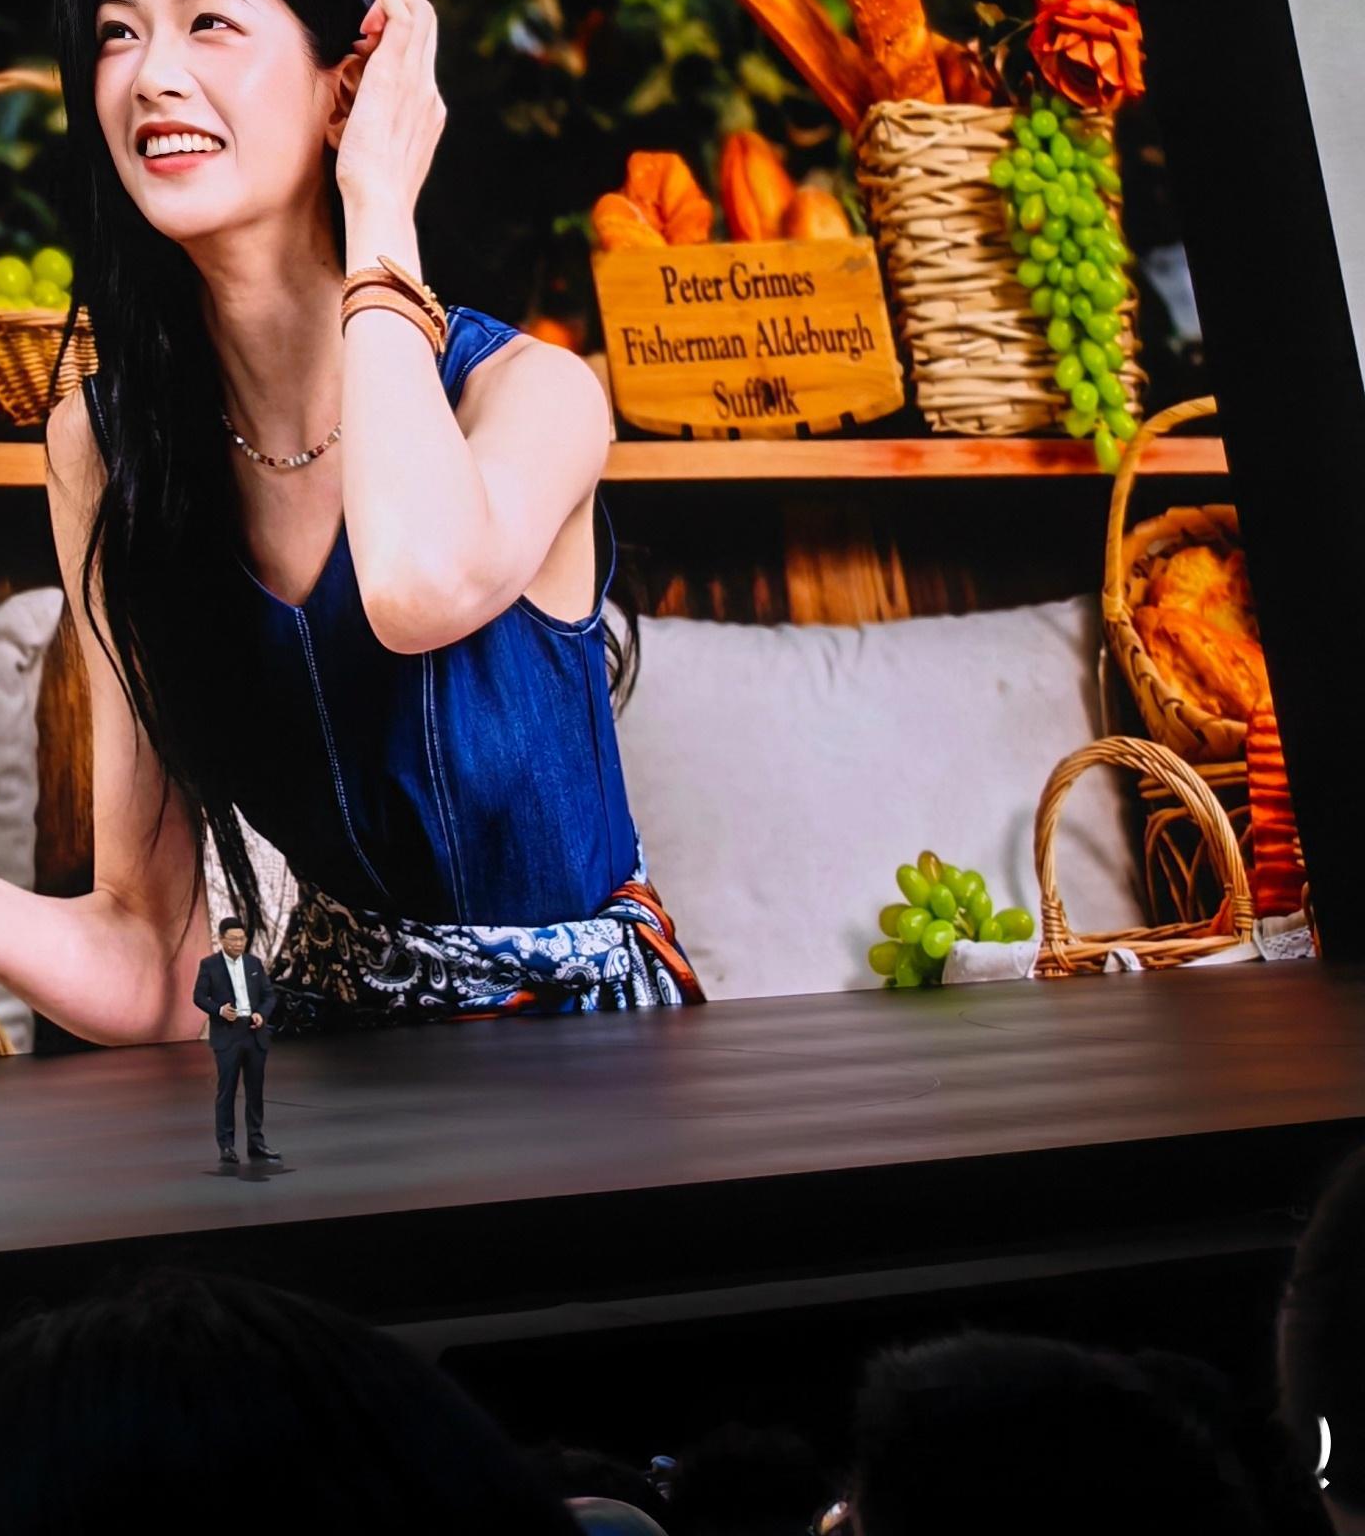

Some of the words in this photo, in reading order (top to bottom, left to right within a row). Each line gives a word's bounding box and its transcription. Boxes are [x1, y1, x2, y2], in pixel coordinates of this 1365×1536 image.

[660, 265, 724, 305] Peter
[729, 261, 816, 301] Grimes
[621, 324, 747, 366] Fisherman
[755, 313, 875, 361] Aldeburgh
